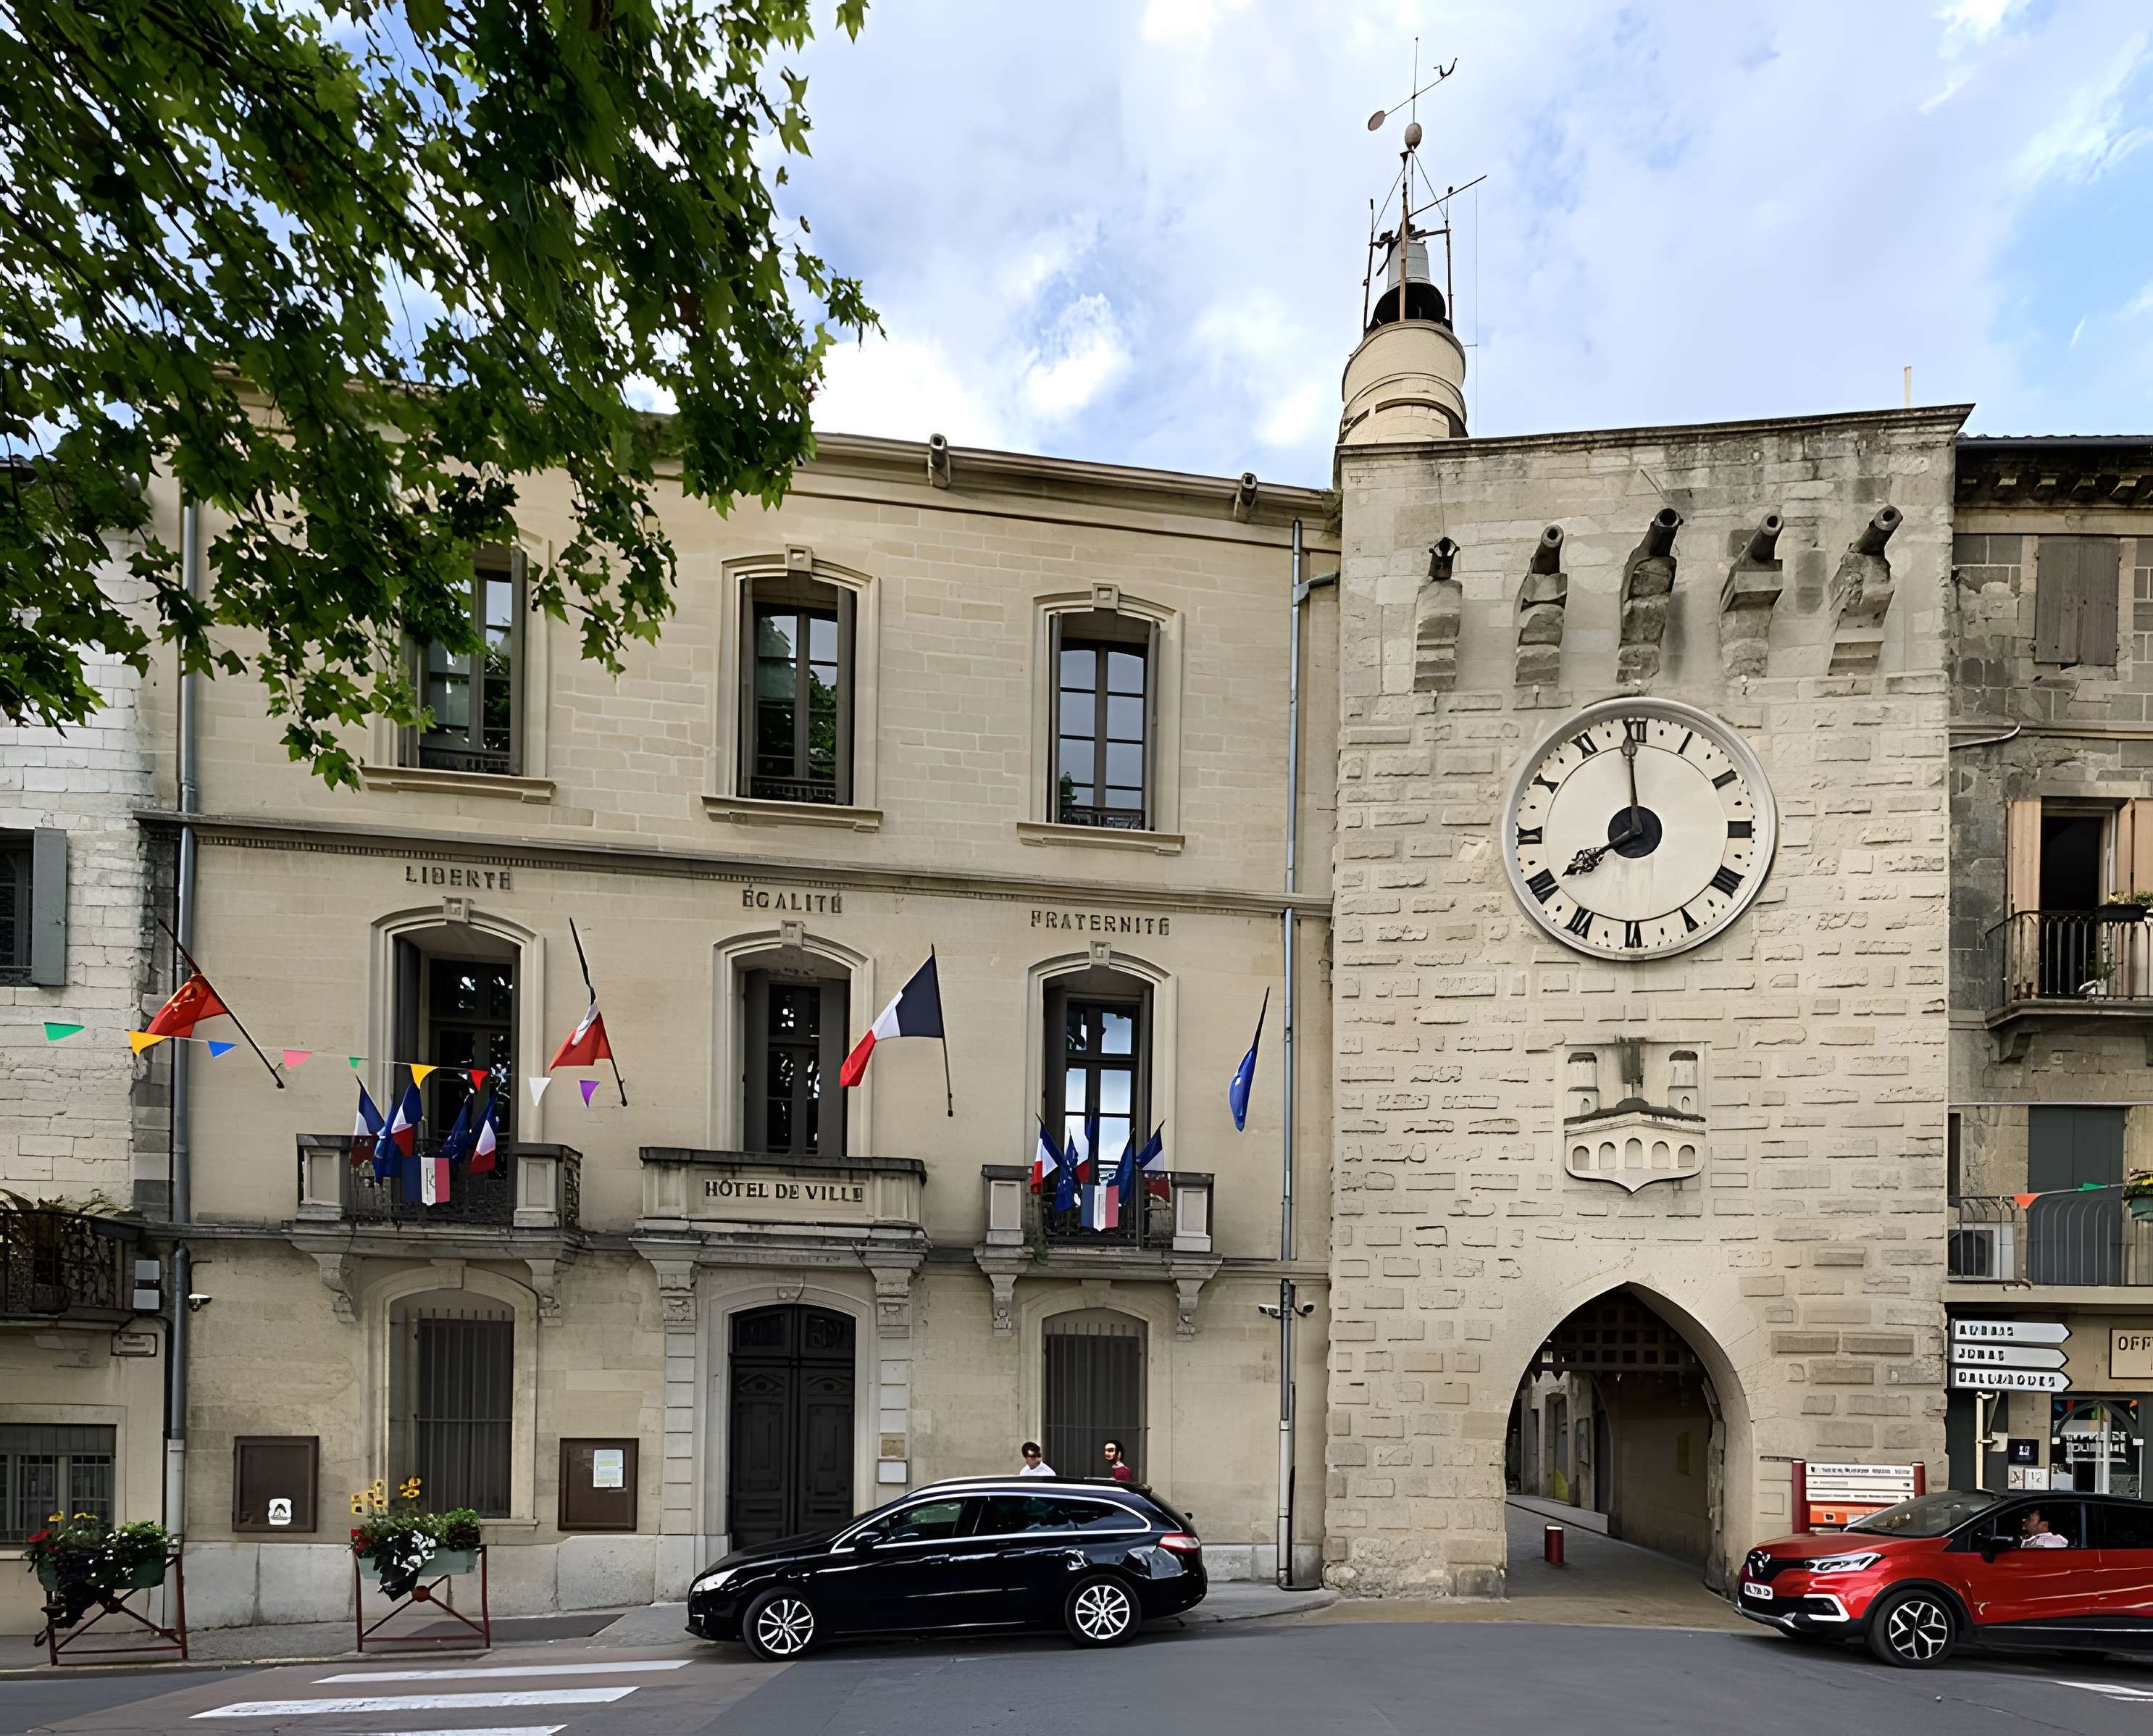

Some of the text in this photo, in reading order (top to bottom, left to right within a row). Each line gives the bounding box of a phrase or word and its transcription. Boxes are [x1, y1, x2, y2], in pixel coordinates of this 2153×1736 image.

[706, 1180, 863, 1202] HÔTEL DE VILLE
